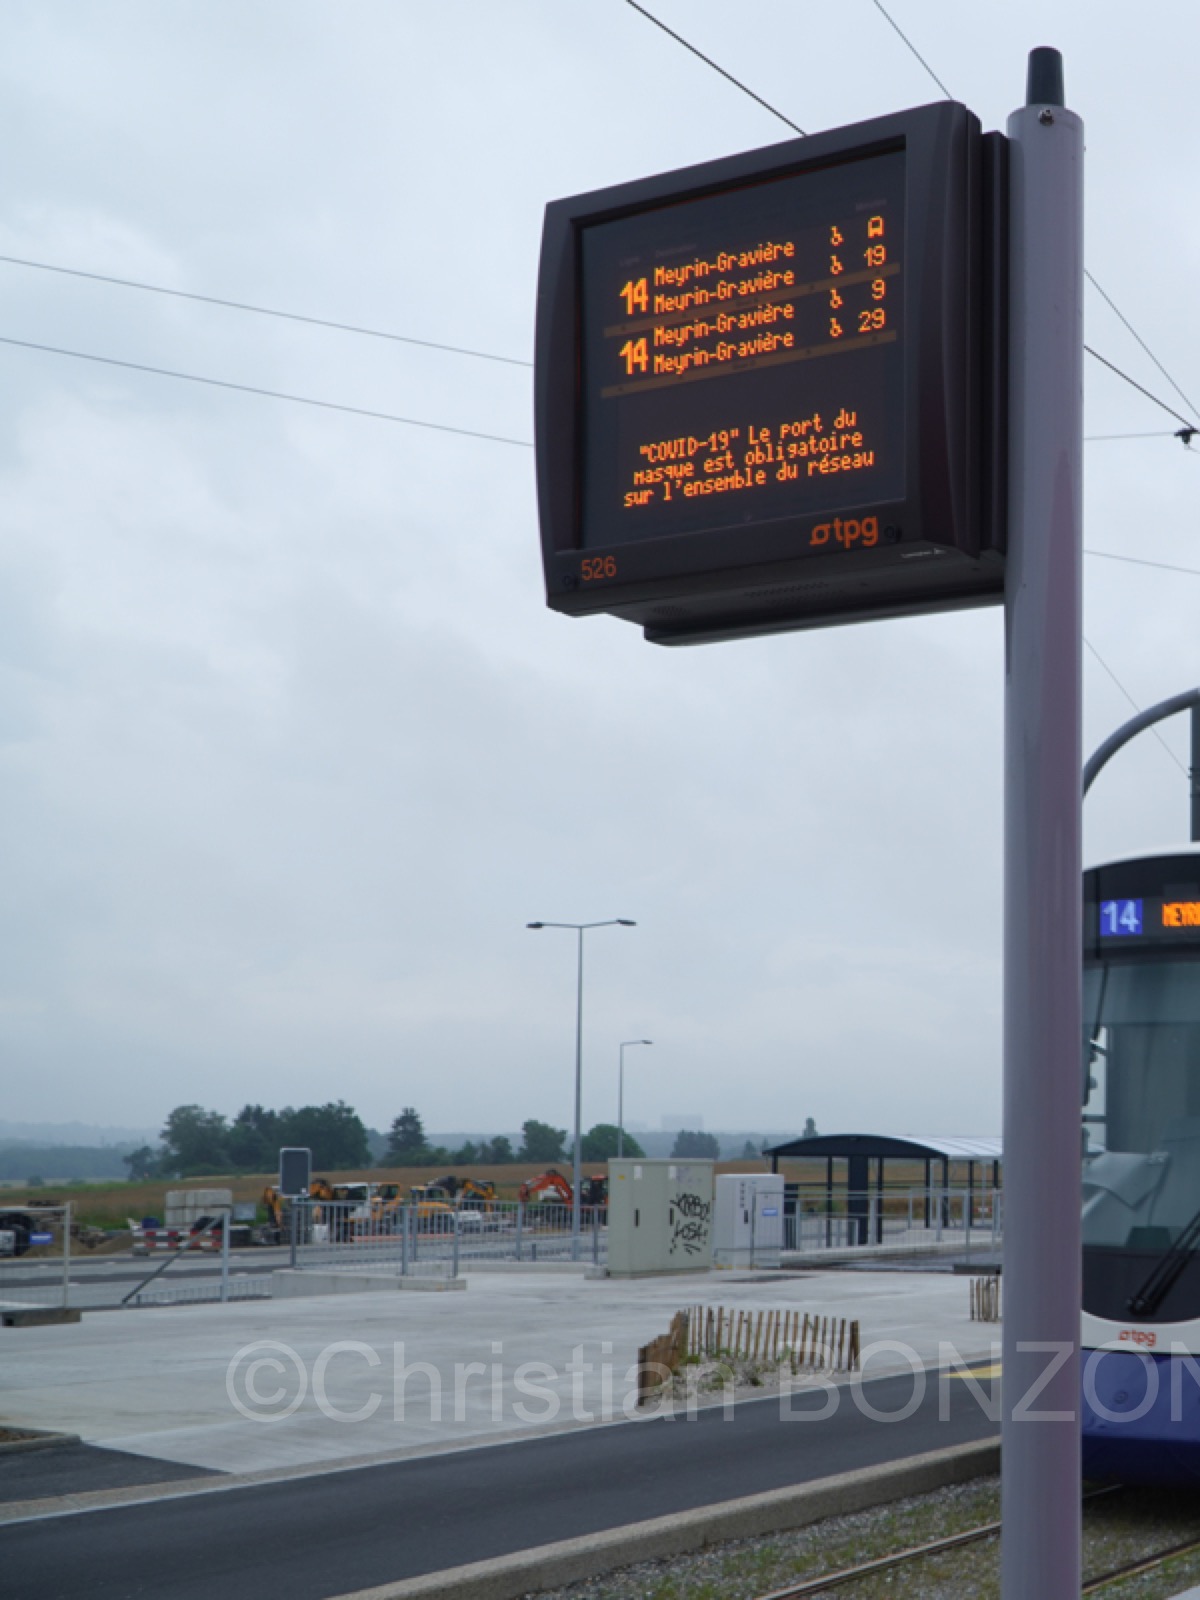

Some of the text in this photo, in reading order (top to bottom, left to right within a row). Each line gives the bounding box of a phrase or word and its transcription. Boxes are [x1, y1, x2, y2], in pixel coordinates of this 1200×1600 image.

[619, 245, 887, 315] 14 Meyrin-Gravière 19
[654, 241, 795, 286] Meyrin-Gravière
[654, 279, 886, 348] Meyrin-Gravière 9
[619, 308, 886, 375] 14 Meyrin-Gravière 29
[633, 431, 864, 486] masque est obligatoire
[639, 428, 740, 463] "COVID-19"
[748, 425, 772, 446] Le
[834, 408, 857, 429] du
[623, 451, 875, 508] sur l'ensemble du réseau
[834, 516, 879, 548] tpg
[581, 556, 617, 581] 526
[1103, 901, 1140, 933] 14
